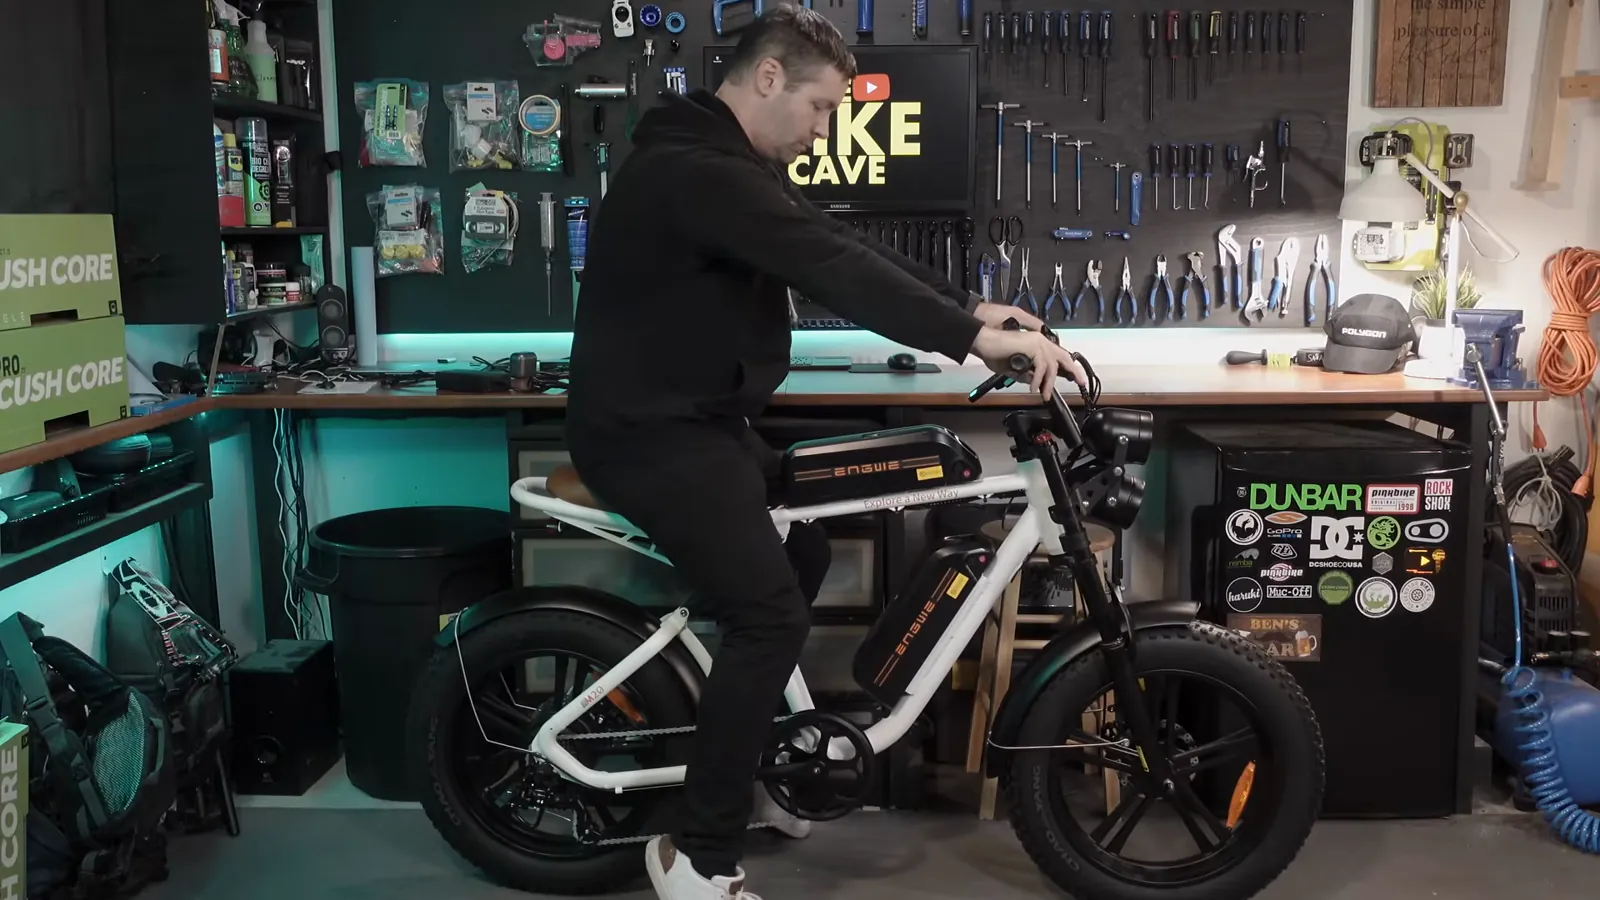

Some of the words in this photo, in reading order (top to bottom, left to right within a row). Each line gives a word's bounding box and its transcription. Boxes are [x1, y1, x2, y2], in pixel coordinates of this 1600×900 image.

[1397, 23, 1459, 40] pleasure
[1463, 22, 1480, 36] of
[1484, 27, 1492, 36] a
[787, 154, 886, 185] CAVE
[51, 253, 113, 285] CORE
[1341, 327, 1387, 339] POLYGON
[0, 368, 63, 409] CUSH
[66, 356, 123, 393] CORE
[1371, 489, 1416, 497] pinkbike
[1425, 480, 1452, 495] ROCK
[864, 495, 901, 509] Explore
[912, 491, 937, 502] New
[937, 488, 960, 501] Way
[1250, 483, 1363, 511] DUNBAR
[1424, 496, 1451, 510] SHOX
[1260, 568, 1304, 577] pinkbike
[1228, 588, 1261, 602] haruki
[1269, 586, 1310, 596] Muc-Off
[1250, 618, 1300, 630] BEN'S
[1, 745, 19, 868] CORE
